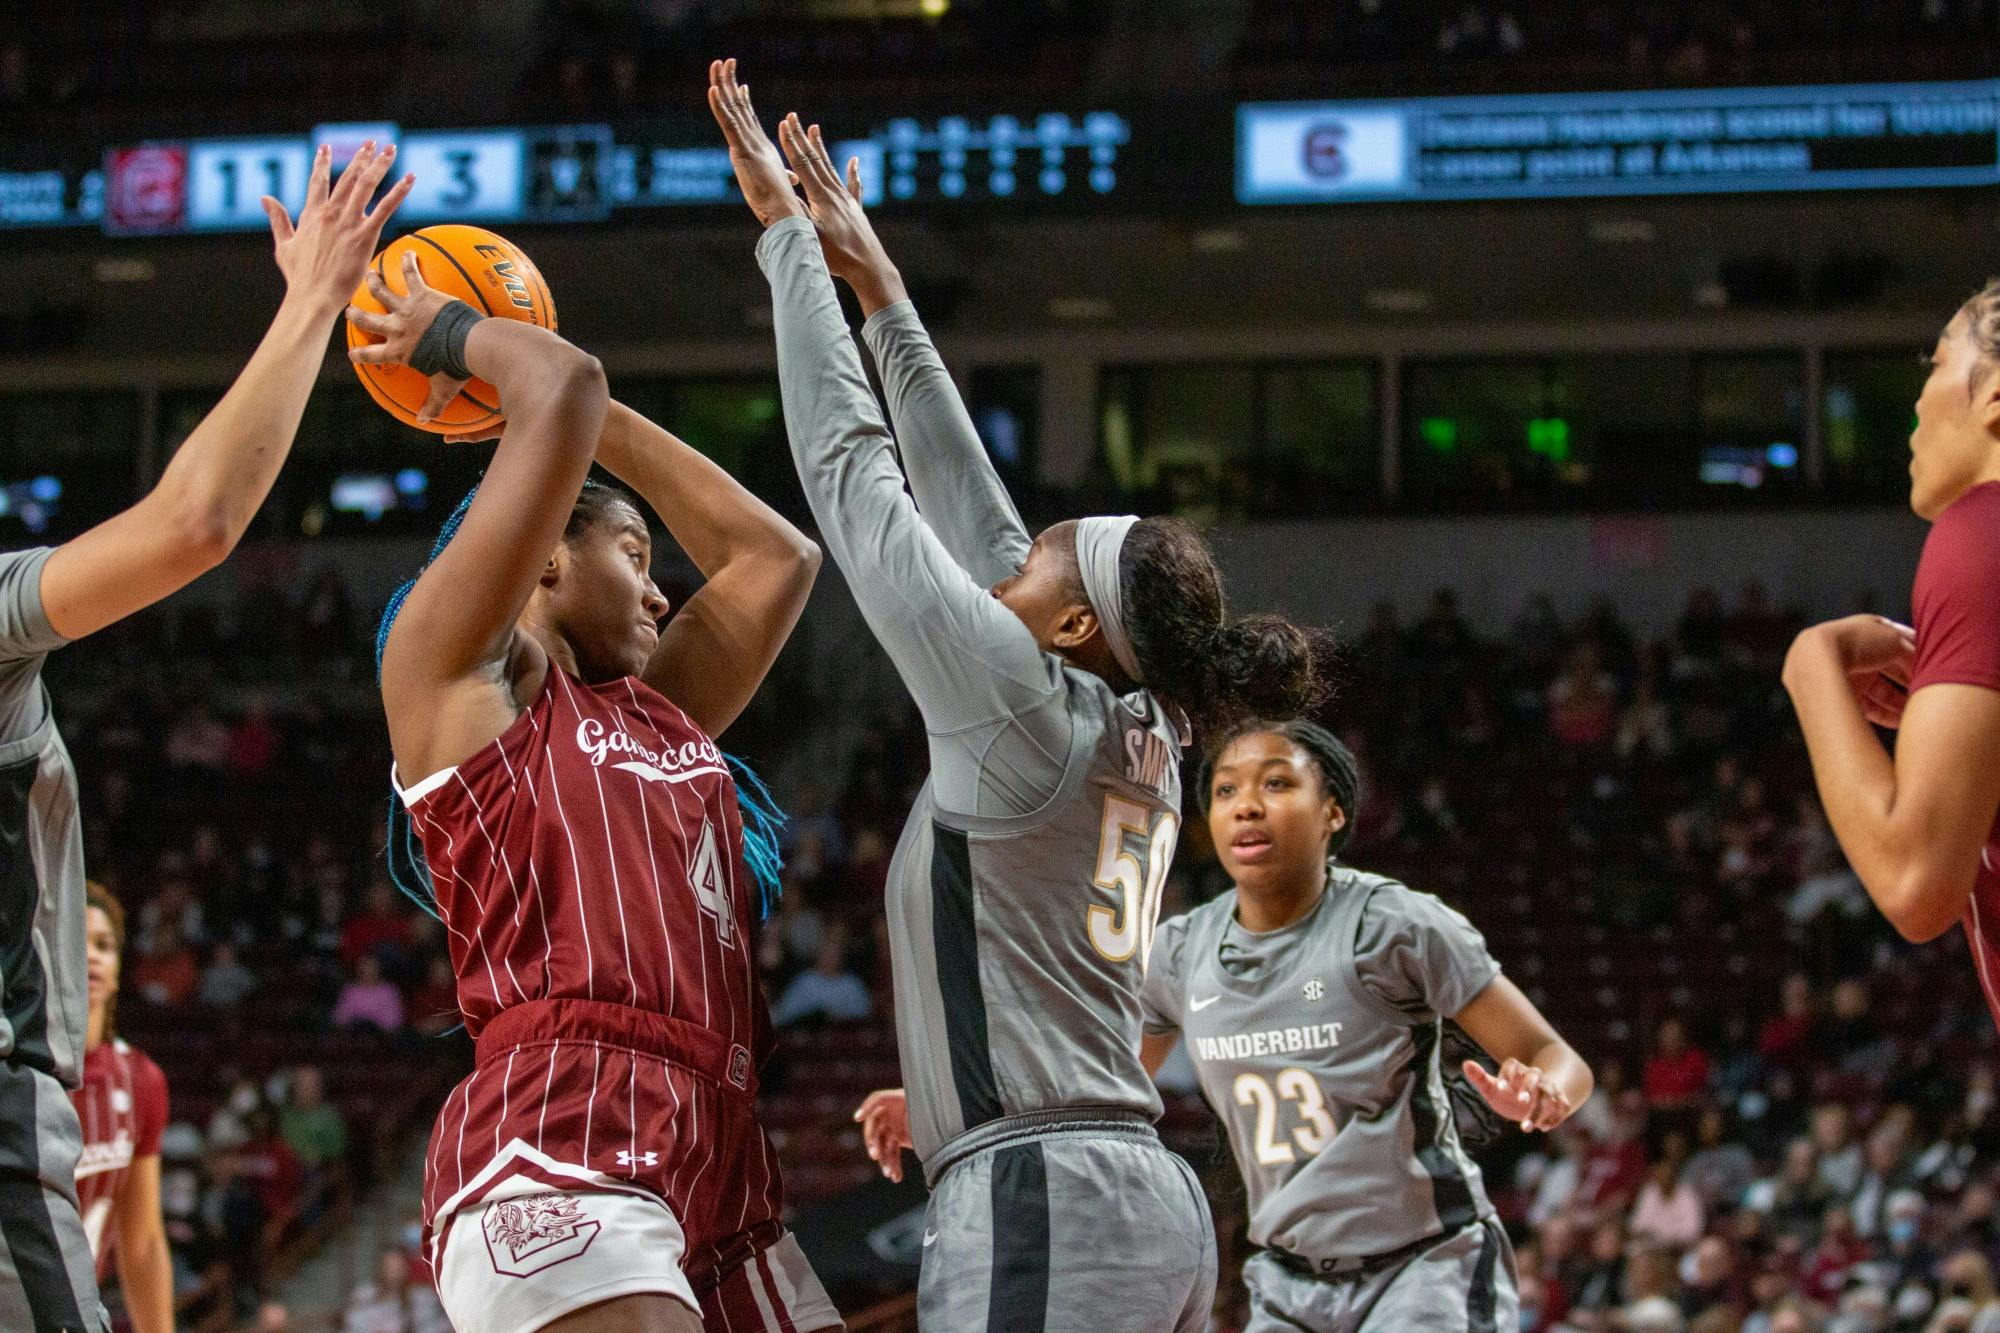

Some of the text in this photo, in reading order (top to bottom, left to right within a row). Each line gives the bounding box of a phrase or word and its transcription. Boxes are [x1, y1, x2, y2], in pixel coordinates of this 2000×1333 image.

[216, 155, 286, 203] 11
[438, 150, 482, 202] 3
[474, 245, 534, 309] EVO
[687, 815, 735, 950] 4
[1196, 1022, 1343, 1061] VANDERBILT
[1233, 1067, 1337, 1165] 23
